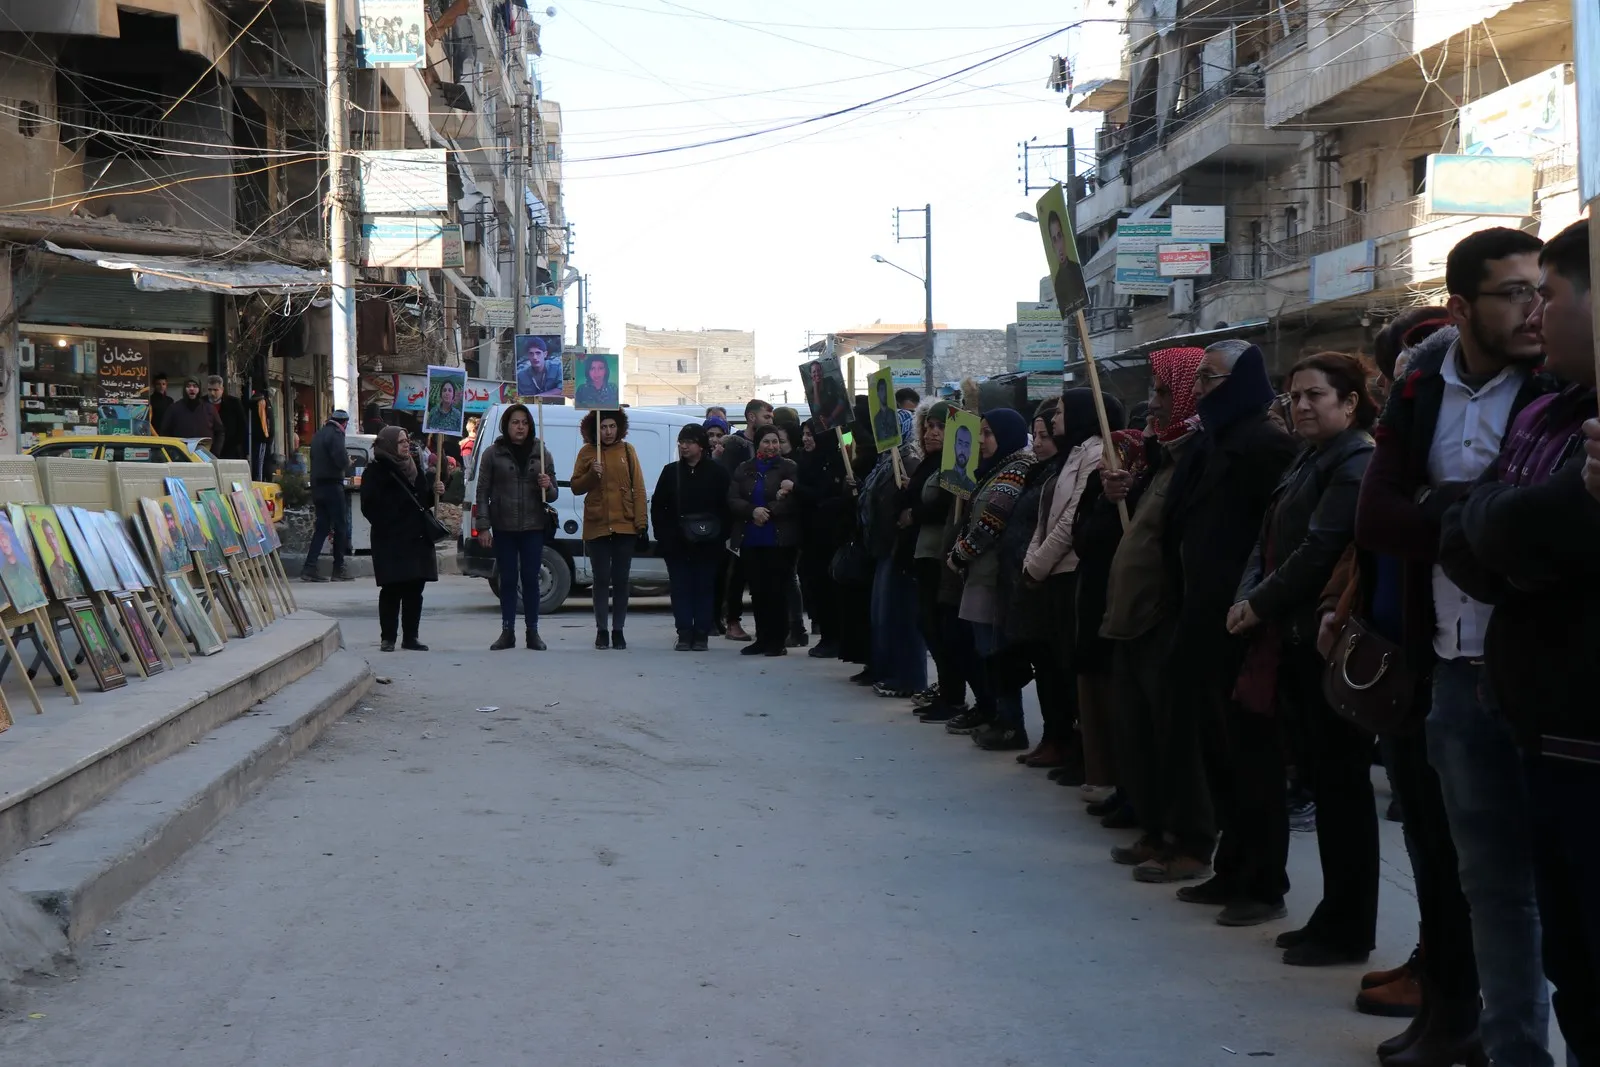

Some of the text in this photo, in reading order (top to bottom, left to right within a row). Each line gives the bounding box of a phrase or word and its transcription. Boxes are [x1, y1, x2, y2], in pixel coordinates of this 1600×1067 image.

[103, 346, 143, 364] عثمان
[99, 365, 148, 380] للإتصالات
[118, 380, 131, 389] شراء
[135, 382, 145, 390] بيع
